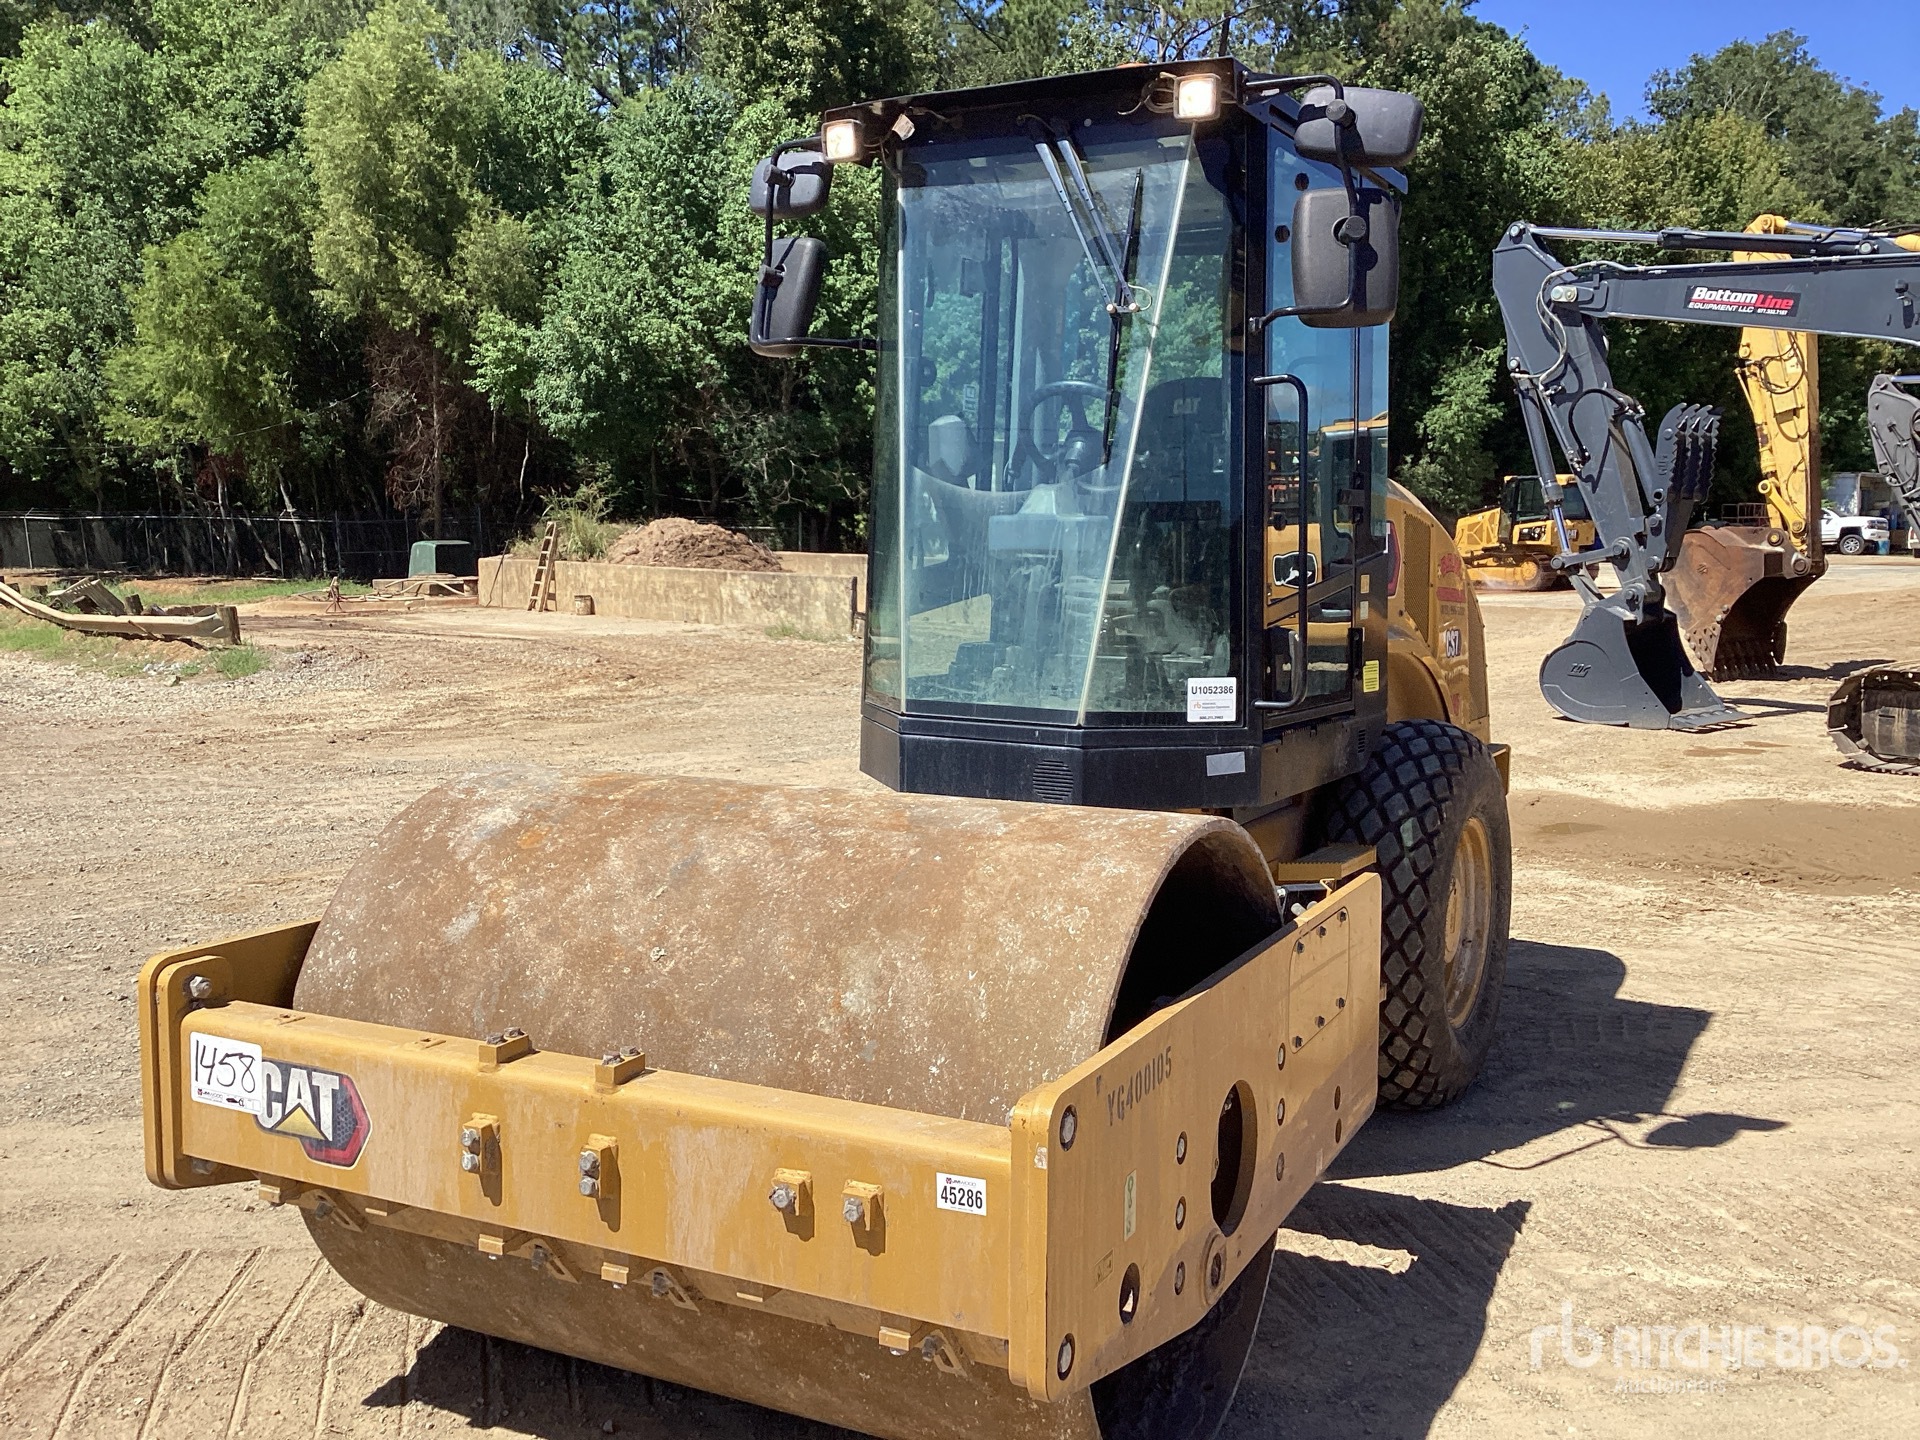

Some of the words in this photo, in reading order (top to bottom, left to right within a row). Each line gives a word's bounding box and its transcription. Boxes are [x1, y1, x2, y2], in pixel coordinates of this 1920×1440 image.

[1688, 302, 1738, 312] EQUIPMENT
[1738, 305, 1755, 313] LLC
[1173, 397, 1201, 415] CAT
[1446, 630, 1461, 658] CS7
[1191, 685, 1234, 695] U1052386
[194, 1039, 256, 1094] 1458
[1107, 1045, 1172, 1127] YG400105
[257, 1061, 340, 1142] CAT
[940, 1185, 983, 1210] 45286
